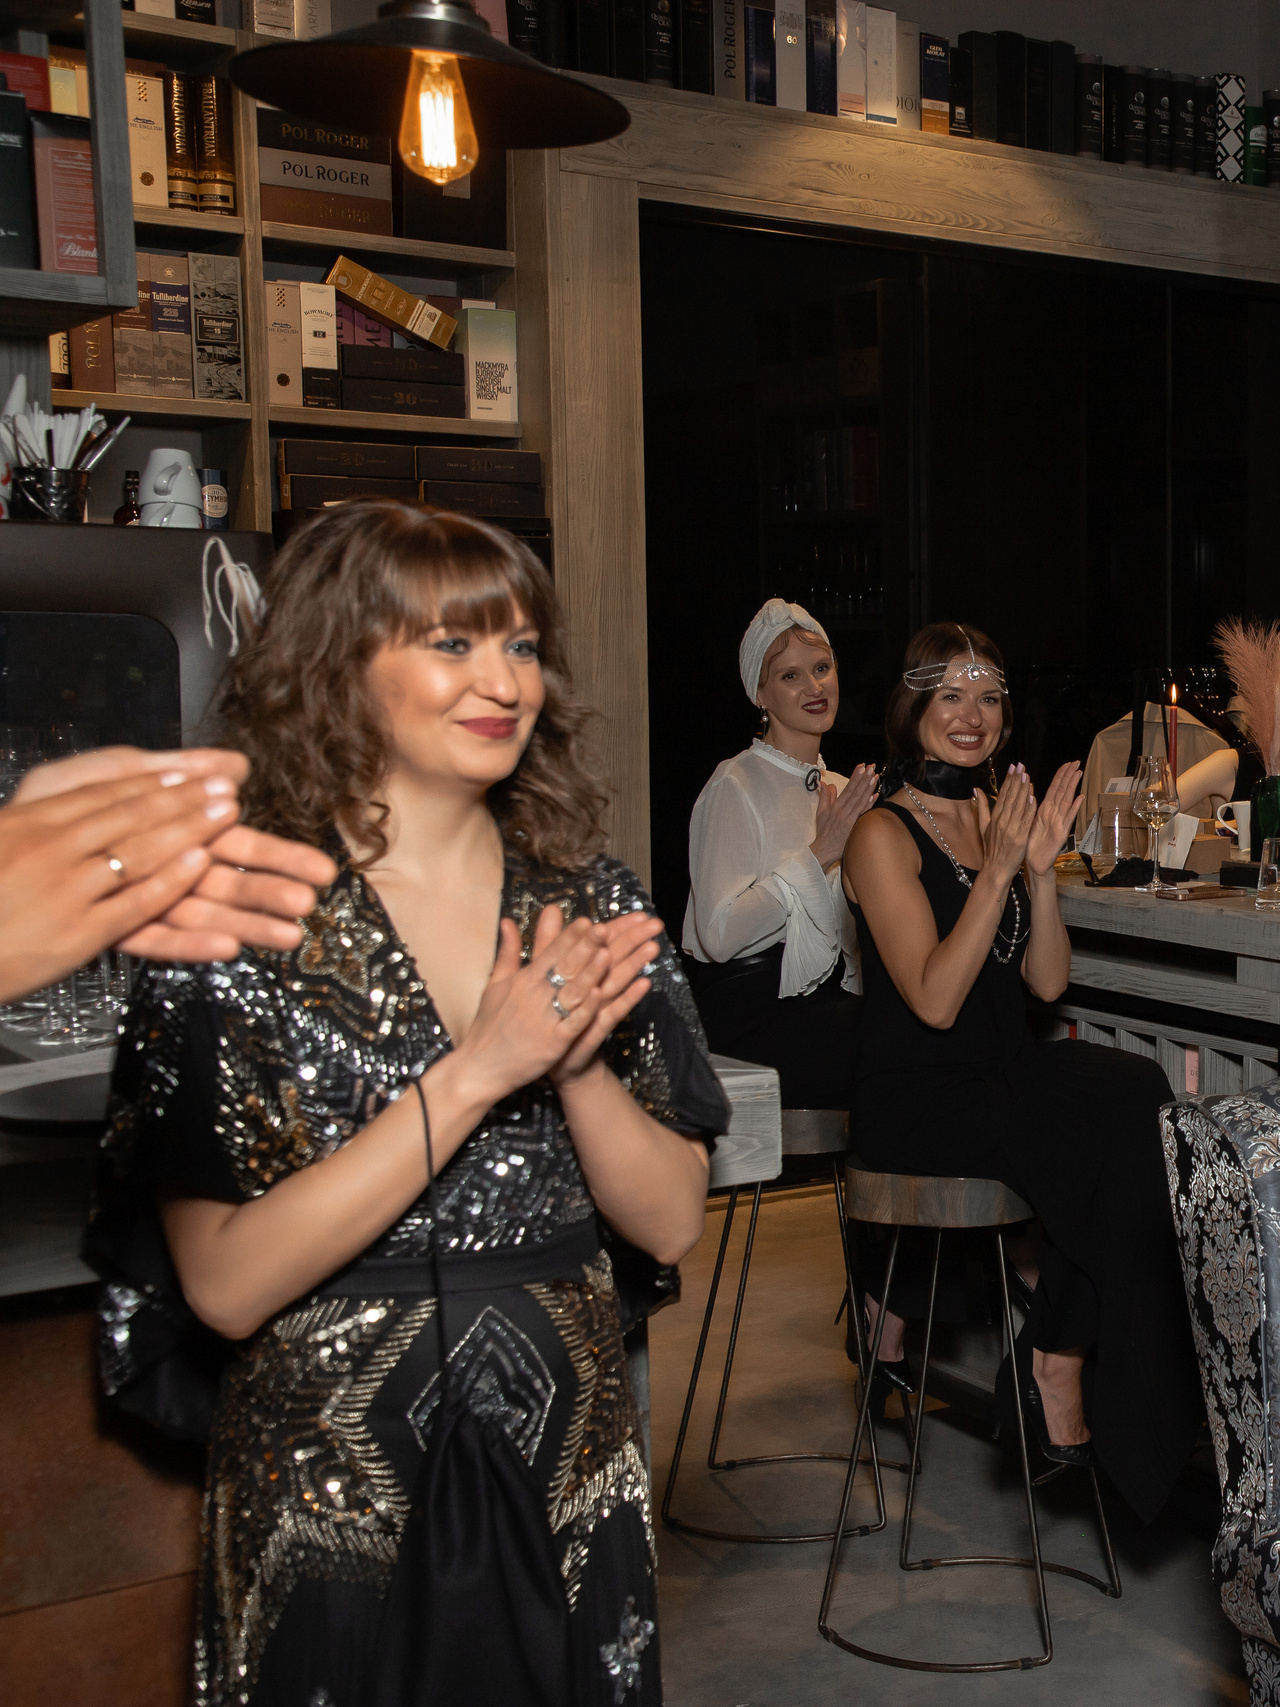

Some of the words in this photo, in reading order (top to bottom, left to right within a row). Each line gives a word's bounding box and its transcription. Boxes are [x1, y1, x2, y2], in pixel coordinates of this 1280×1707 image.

[723, 0, 737, 48] ROGER
[786, 35, 798, 45] 60
[723, 51, 736, 79] POL
[280, 122, 313, 142] POL
[314, 128, 370, 150] ROGER
[281, 160, 314, 179] POL
[315, 165, 370, 186] ROGER
[152, 291, 189, 303] Tullibardine
[303, 309, 335, 318] BOWMORE
[475, 361, 509, 372] MACKMYRA
[475, 376, 502, 386] SWEDISH
[476, 384, 497, 394] SINGLE
[497, 385, 512, 394] MALT
[393, 391, 418, 406] 20
[476, 391, 499, 401] WHISKY
